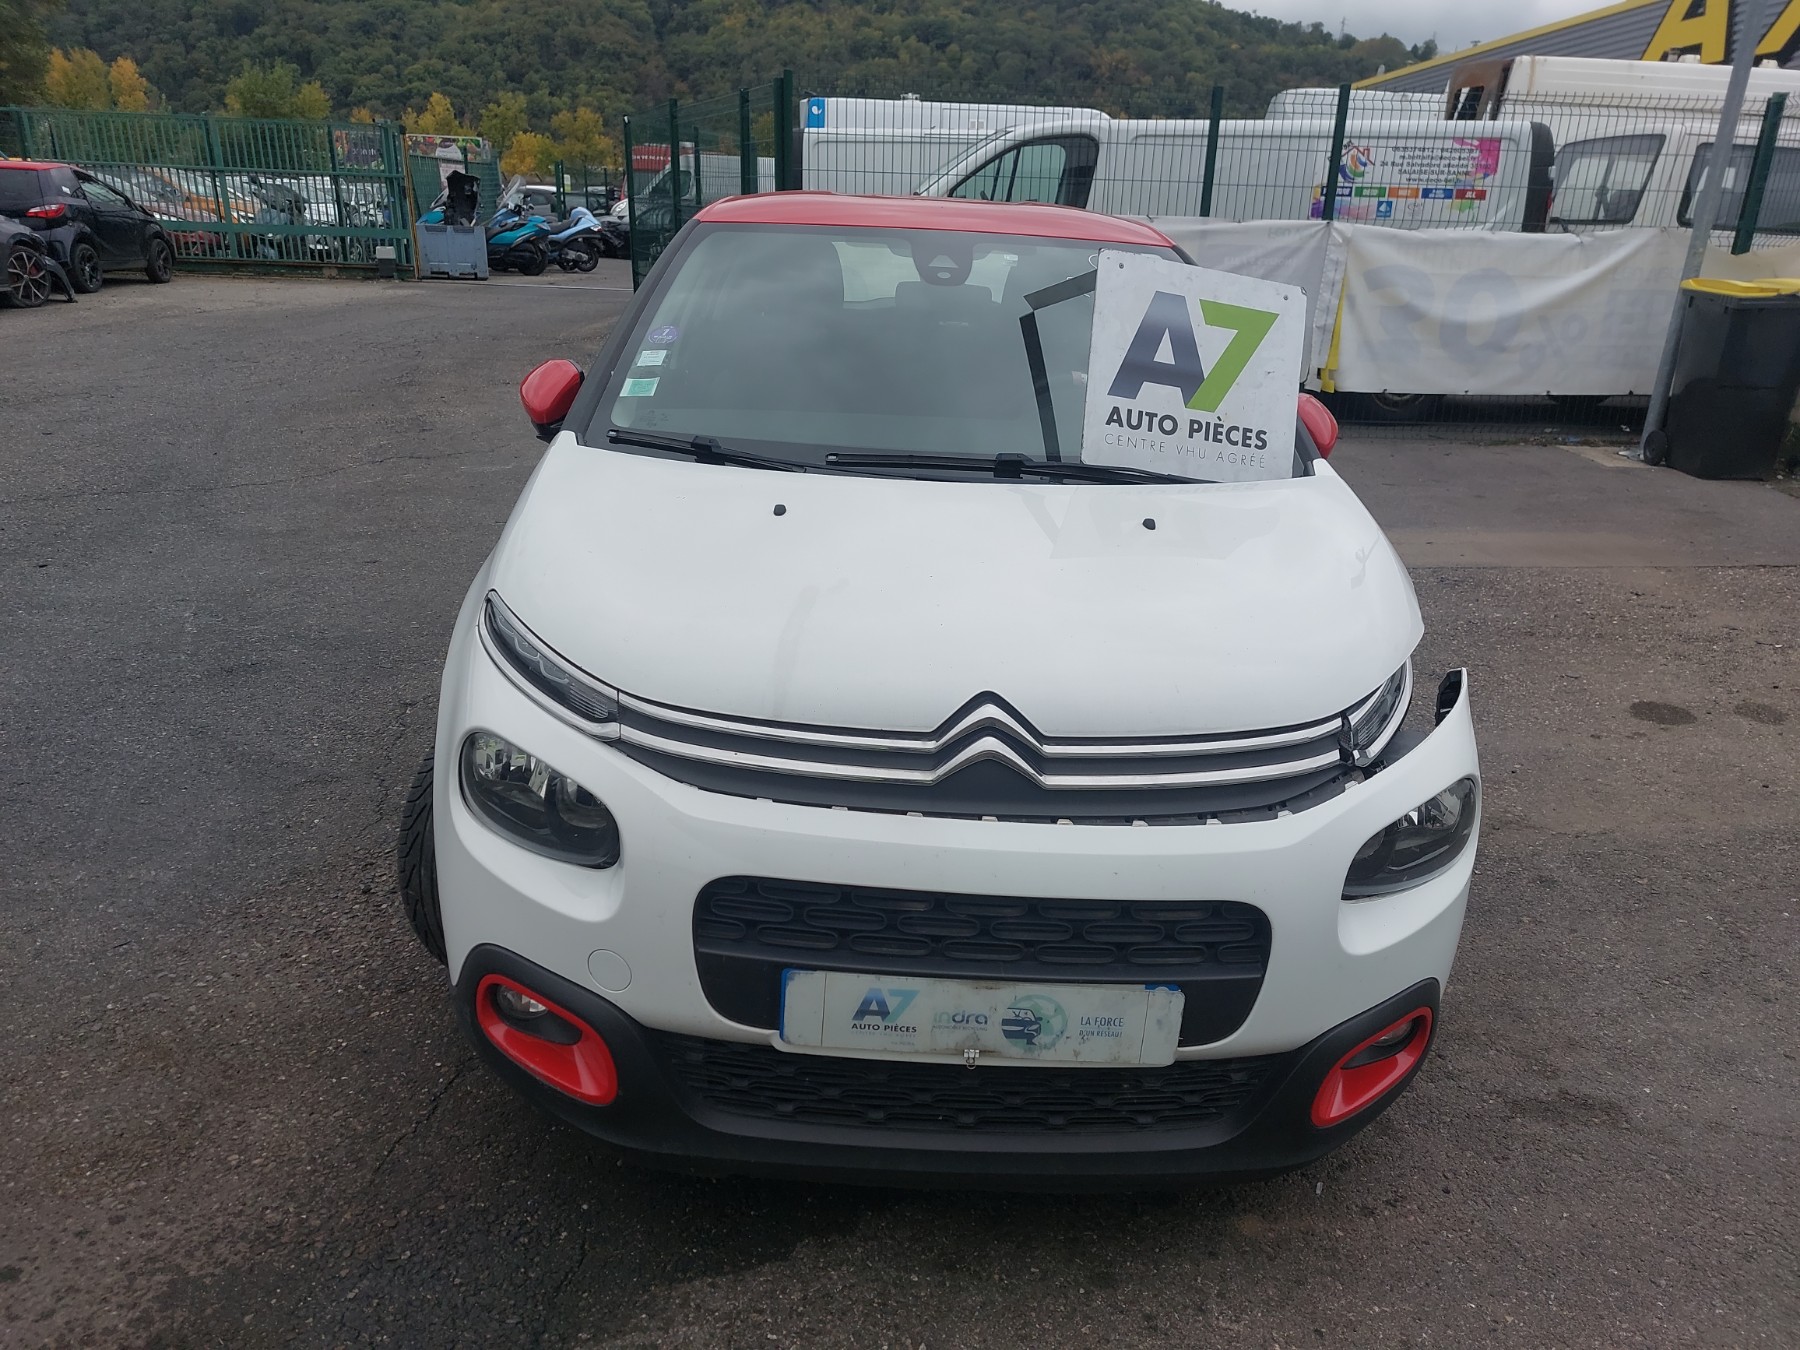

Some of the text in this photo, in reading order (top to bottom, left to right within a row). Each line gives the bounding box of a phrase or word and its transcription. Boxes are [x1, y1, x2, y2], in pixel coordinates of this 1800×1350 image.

[1107, 291, 1280, 413] A7
[1105, 406, 1268, 450] AUTO PIÈCES
[1104, 433, 1265, 469] CENTRE VHU AGRÉÉ
[851, 987, 988, 1025] A7 indra
[1080, 1016, 1124, 1027] LA FORCE
[851, 1023, 917, 1033] AUTO PIÈCES
